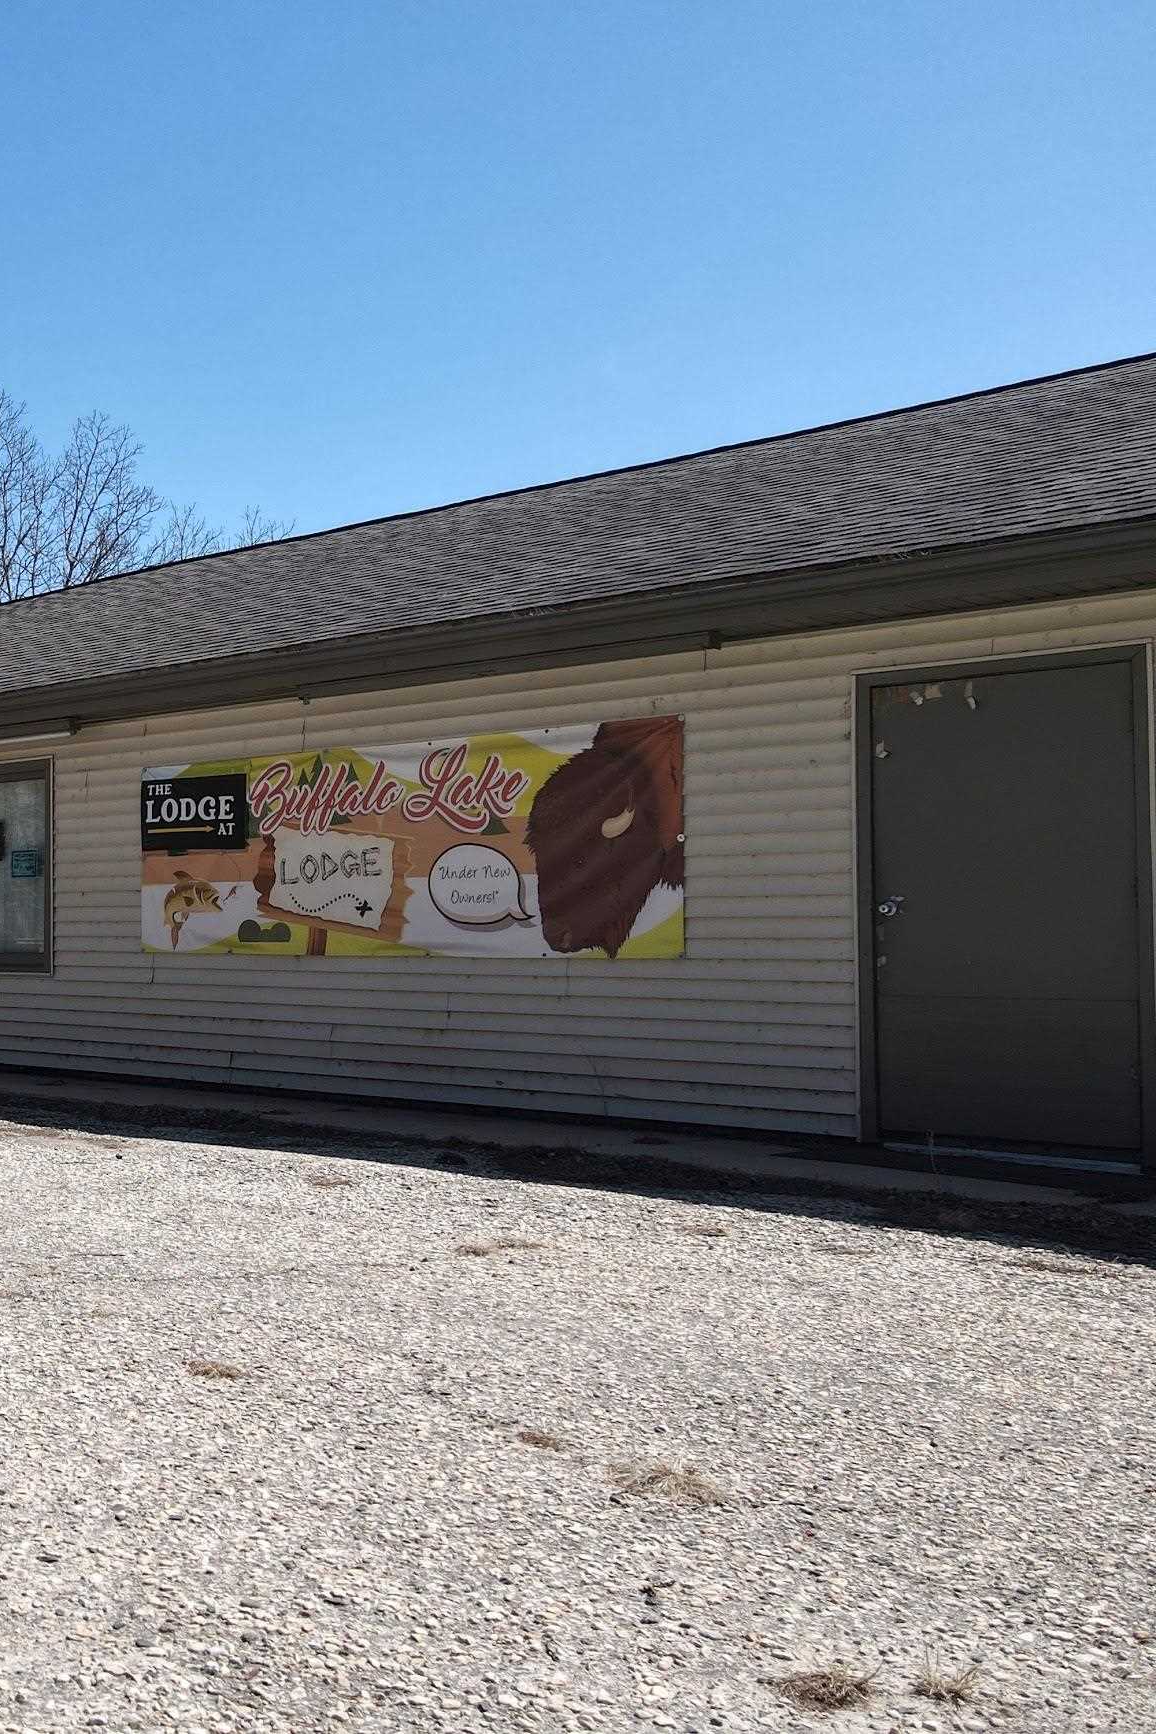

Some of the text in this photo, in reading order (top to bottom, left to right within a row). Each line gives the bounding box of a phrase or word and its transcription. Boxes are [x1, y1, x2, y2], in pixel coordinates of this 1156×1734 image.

[147, 784, 172, 796] THE
[247, 743, 528, 836] Buffalo Lake
[146, 796, 234, 823] LODGE
[218, 823, 235, 835] AT
[280, 847, 382, 885] LODGE
[439, 865, 511, 880] Under New
